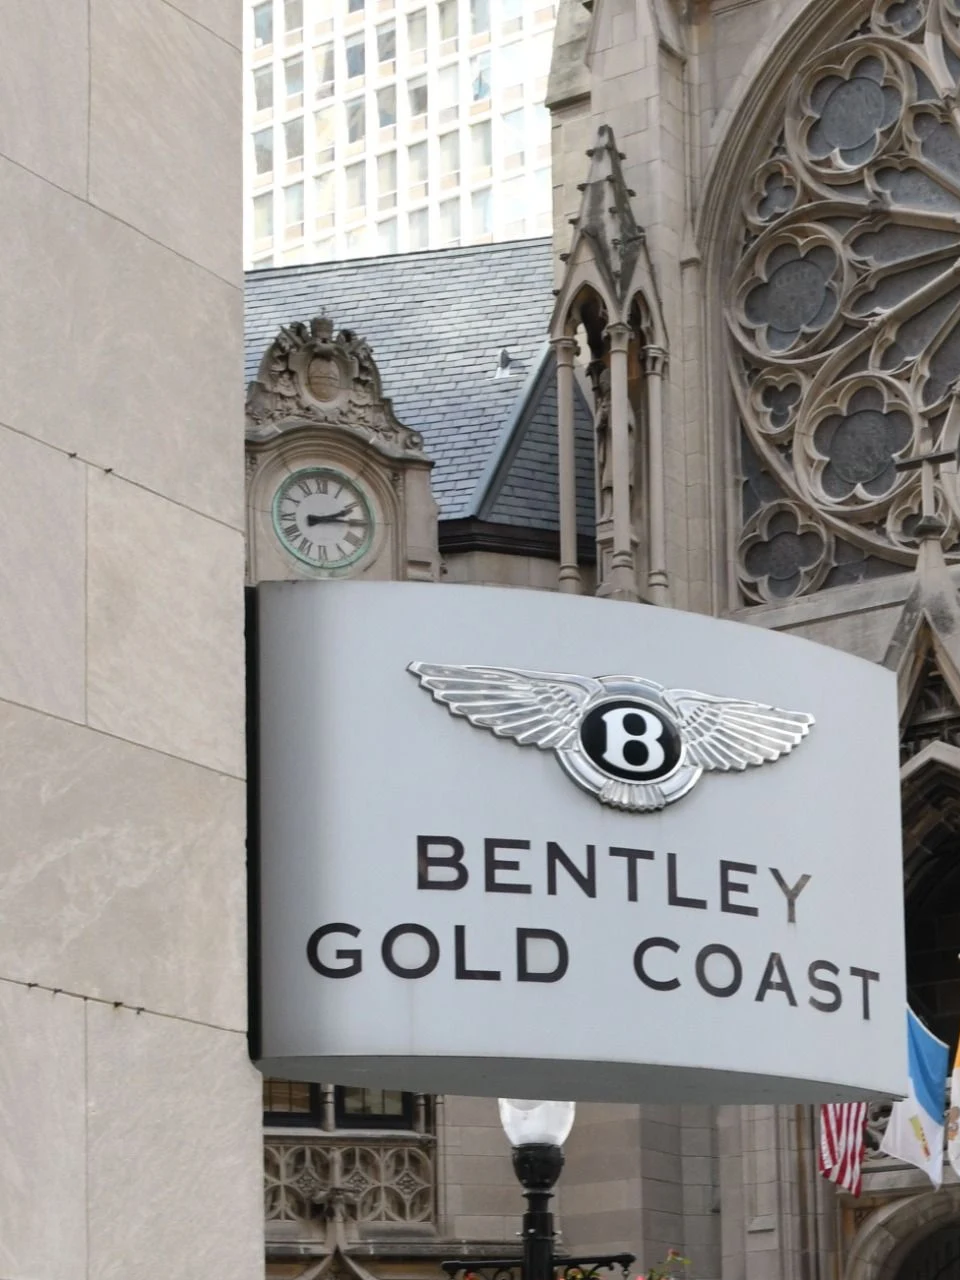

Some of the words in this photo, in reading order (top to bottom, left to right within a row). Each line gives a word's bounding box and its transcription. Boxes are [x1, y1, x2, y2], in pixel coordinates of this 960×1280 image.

[600, 706, 667, 774] B
[416, 834, 813, 924] BENTLEY
[306, 922, 570, 984] GOLD
[632, 936, 881, 1021] COAST
